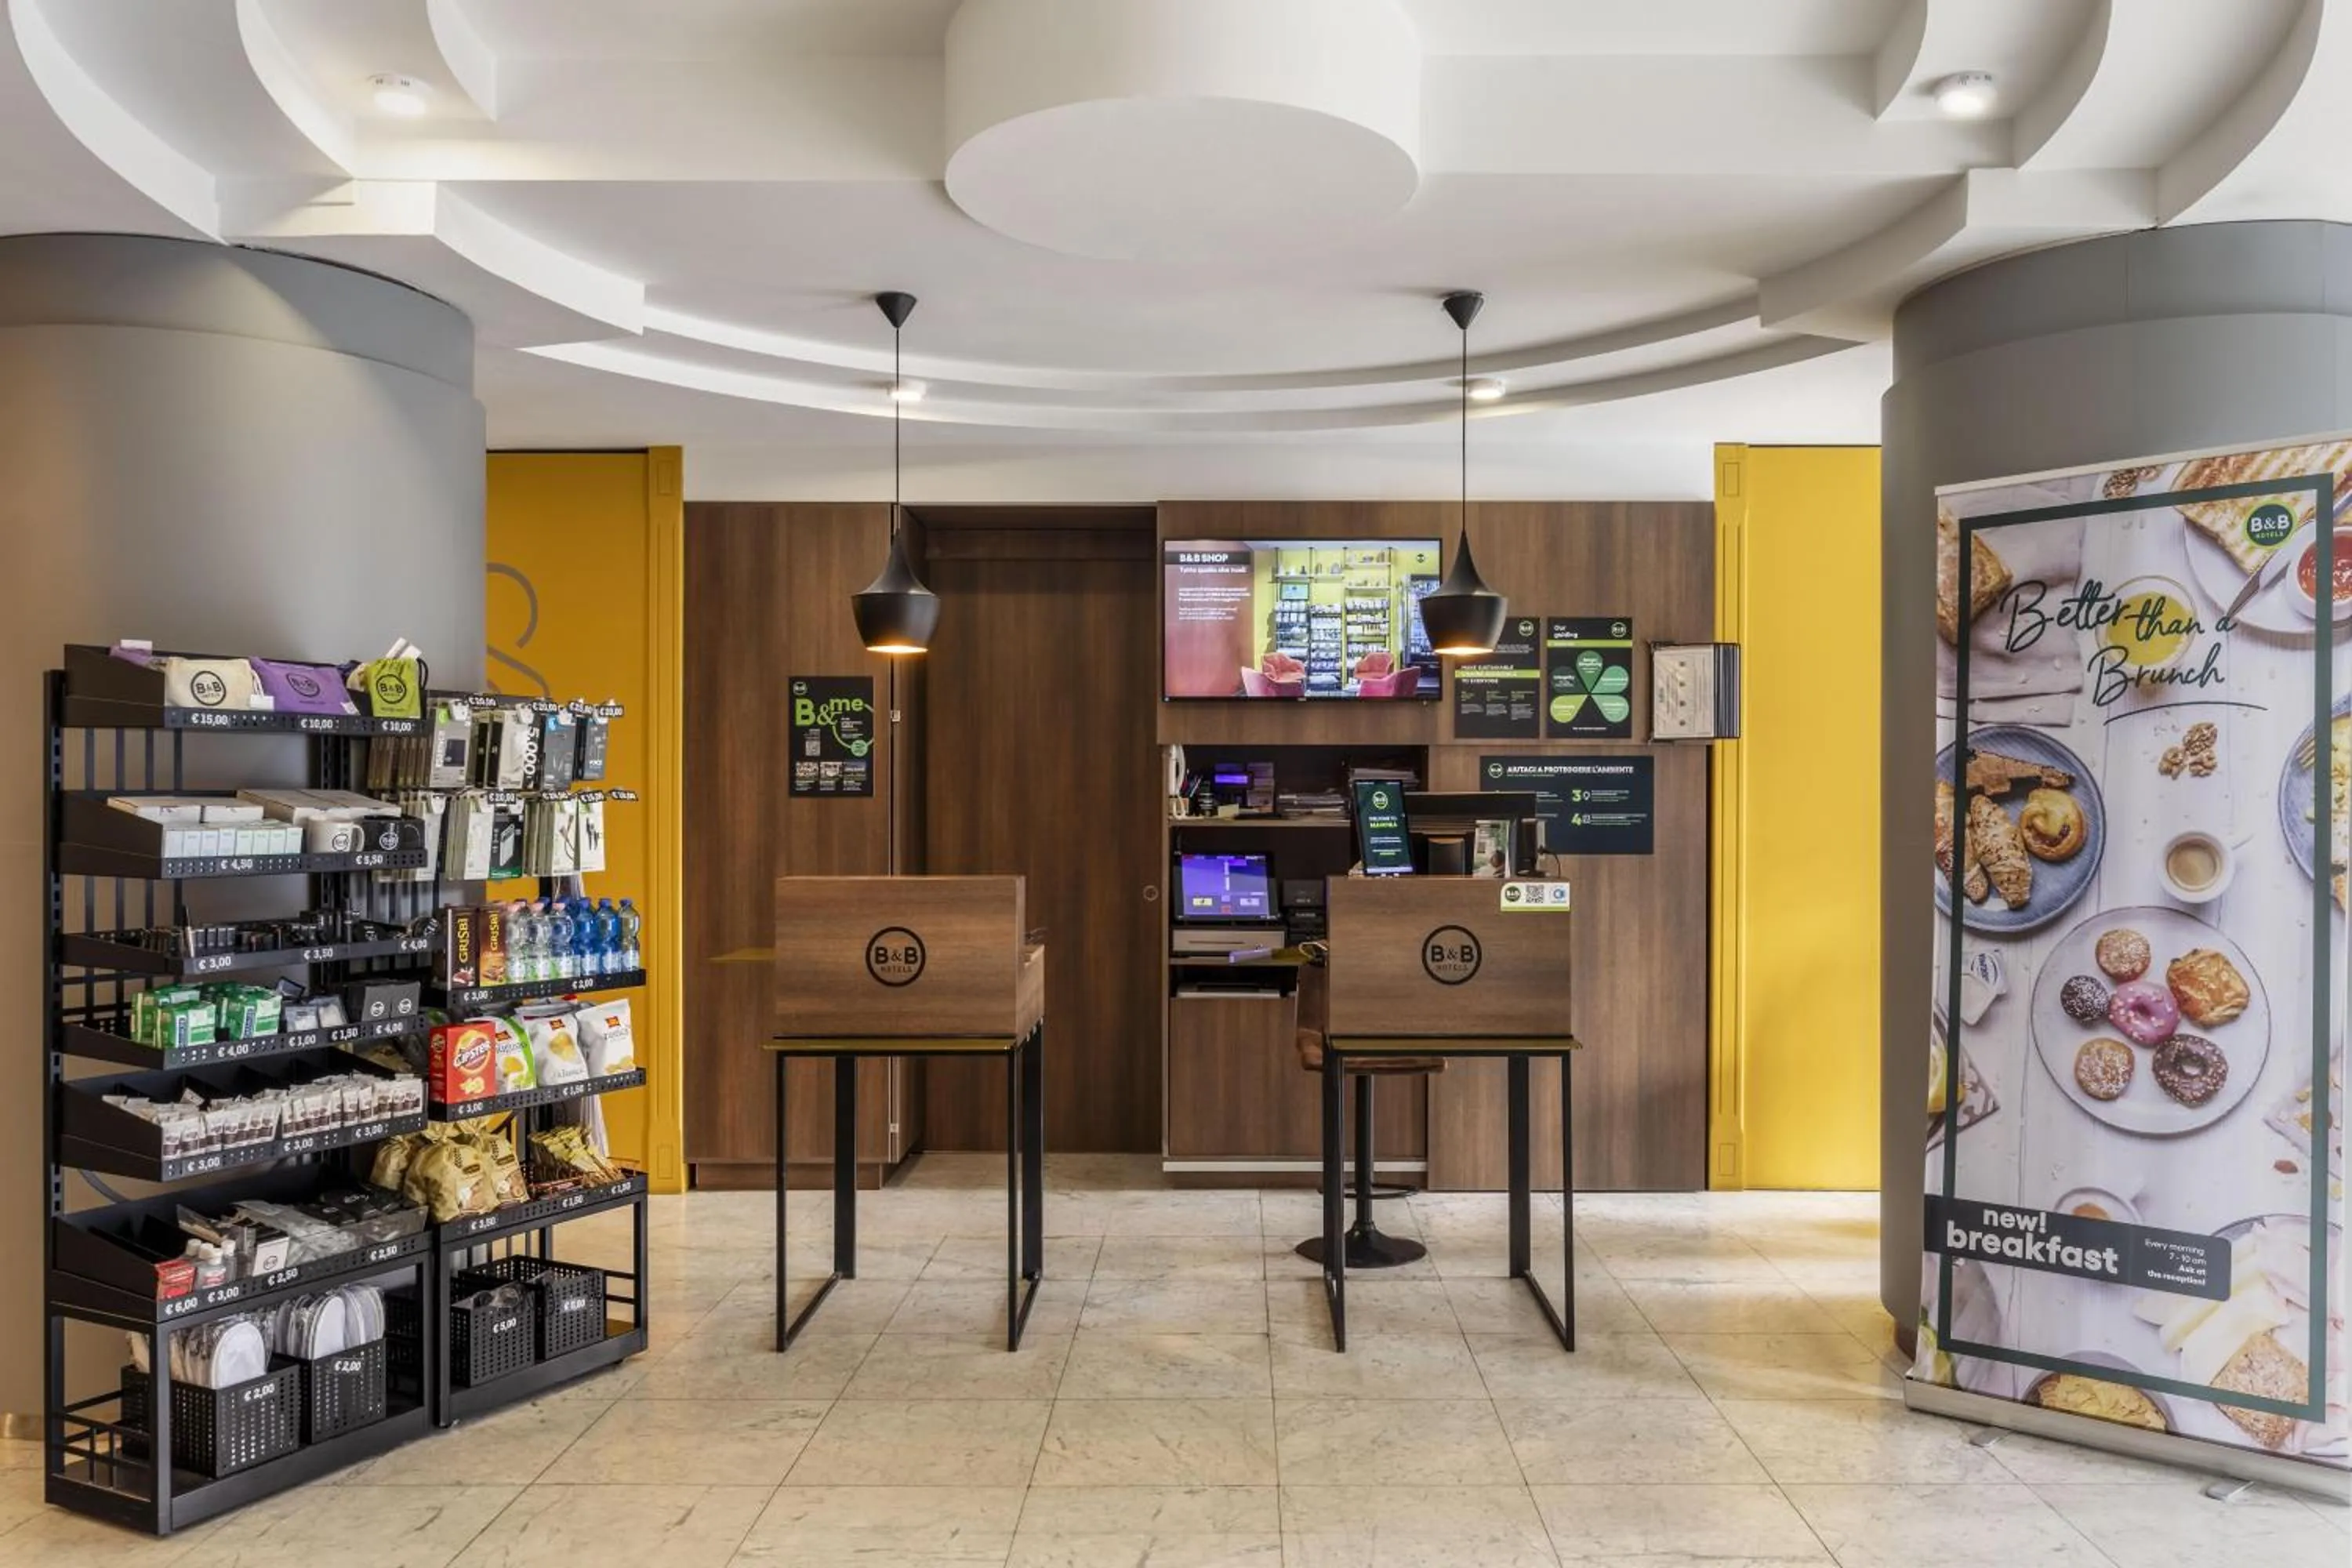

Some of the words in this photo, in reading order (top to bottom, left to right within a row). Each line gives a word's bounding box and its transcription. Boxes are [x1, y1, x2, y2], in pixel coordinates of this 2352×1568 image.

[2251, 514, 2290, 532] B&B
[1201, 554, 1229, 562] SHOP
[2000, 579, 2129, 653] Better
[2125, 597, 2205, 641] than
[2216, 617, 2238, 633] a
[2087, 643, 2225, 706] Brunch
[196, 681, 222, 694] B&B
[379, 683, 404, 694] B&B
[1572, 789, 1581, 801] 3
[1571, 813, 1581, 826] 4
[313, 946, 333, 960] 3,50
[874, 946, 919, 964] B&B
[1431, 945, 1475, 963] B&B
[209, 955, 232, 970] 3,00
[297, 1034, 316, 1048] 1,00
[339, 1027, 358, 1041] 1,50
[226, 1044, 249, 1058] 4,00
[363, 1123, 384, 1138] 3,00
[293, 1137, 314, 1152] 3,00
[198, 1156, 220, 1171] 3,00
[1983, 1209, 2047, 1233] new!
[1947, 1220, 2119, 1274] breakfast
[2144, 1239, 2168, 1250] Every
[2169, 1244, 2205, 1256] morning
[2181, 1254, 2190, 1263] 10
[277, 1267, 299, 1283] 2,50
[2179, 1264, 2195, 1274] Ask
[2147, 1269, 2161, 1279] the
[2162, 1273, 2205, 1286] reception!
[216, 1286, 240, 1301] 3,00
[175, 1297, 198, 1313] 6,00
[342, 1360, 362, 1374] 2,00
